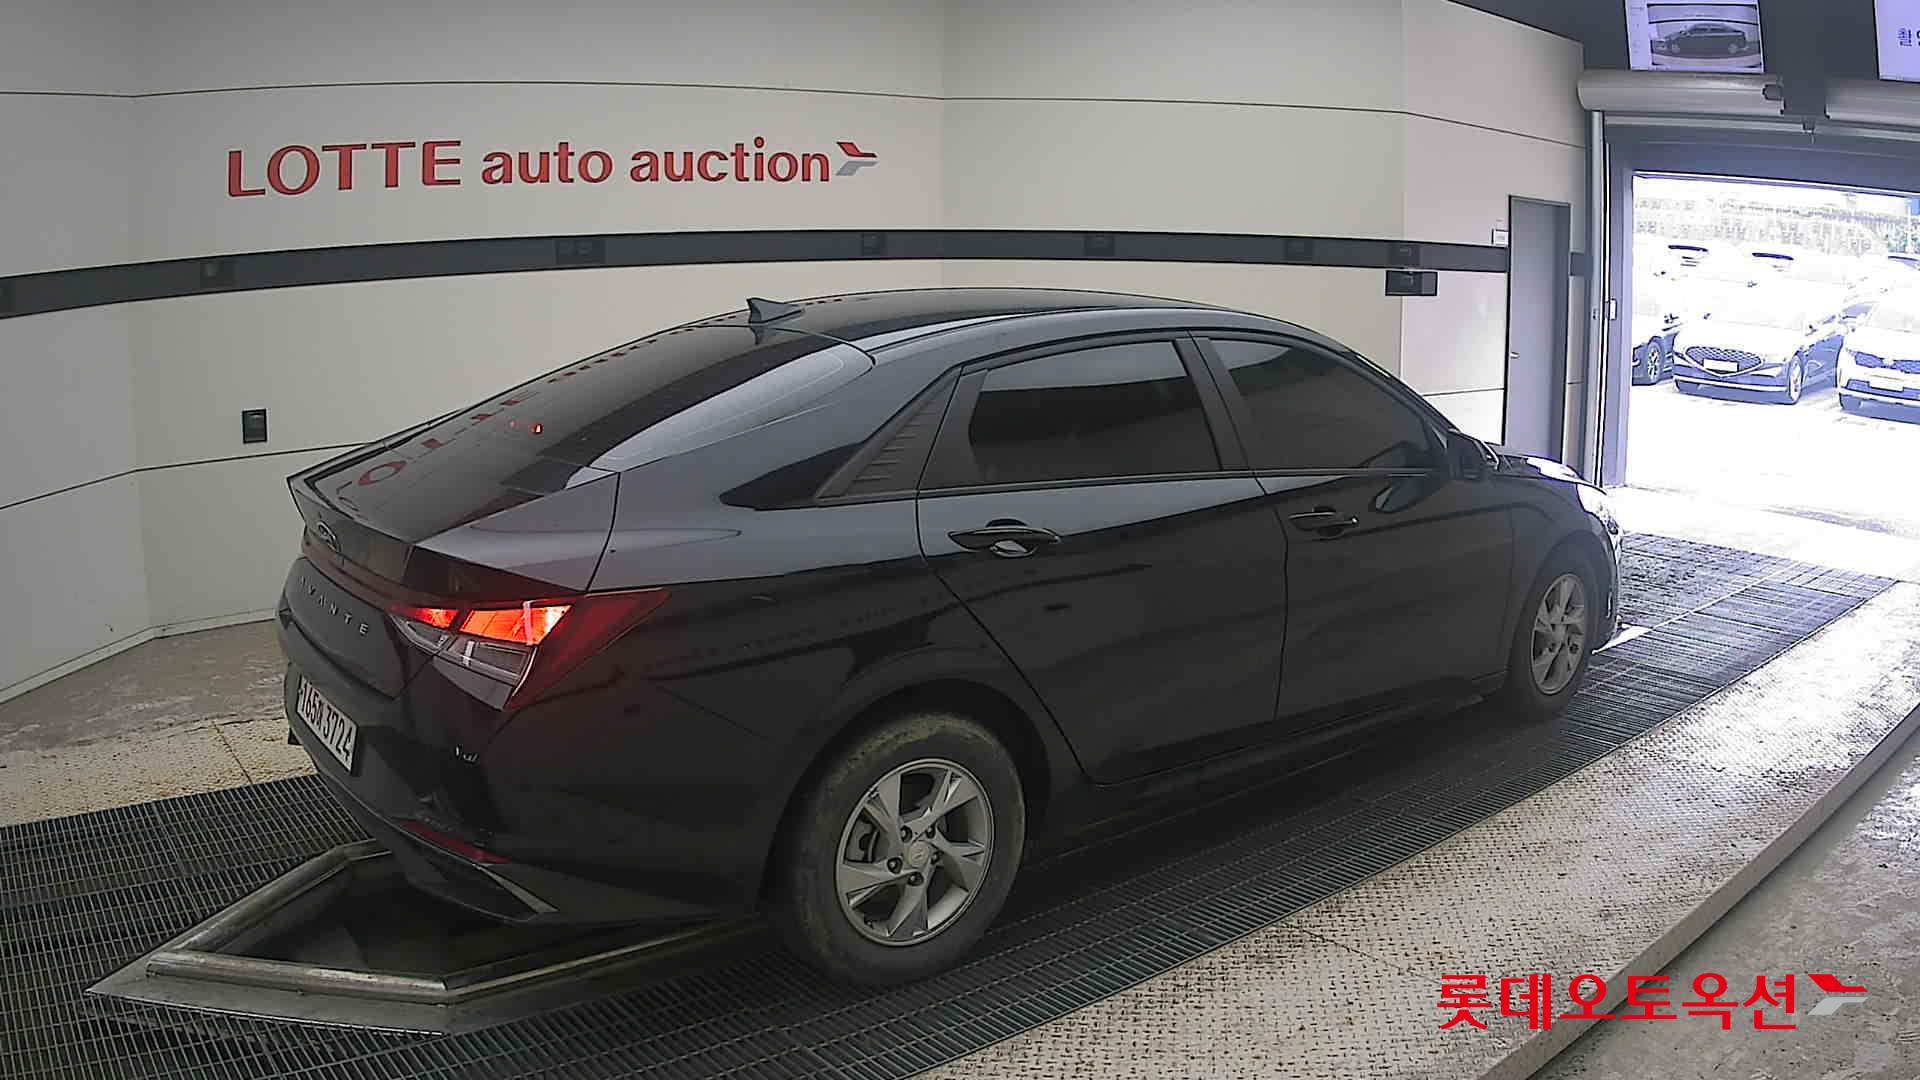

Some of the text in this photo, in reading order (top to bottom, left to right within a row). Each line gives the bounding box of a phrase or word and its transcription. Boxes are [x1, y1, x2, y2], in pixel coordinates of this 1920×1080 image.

[228, 136, 832, 197] LOTTE auto auction
